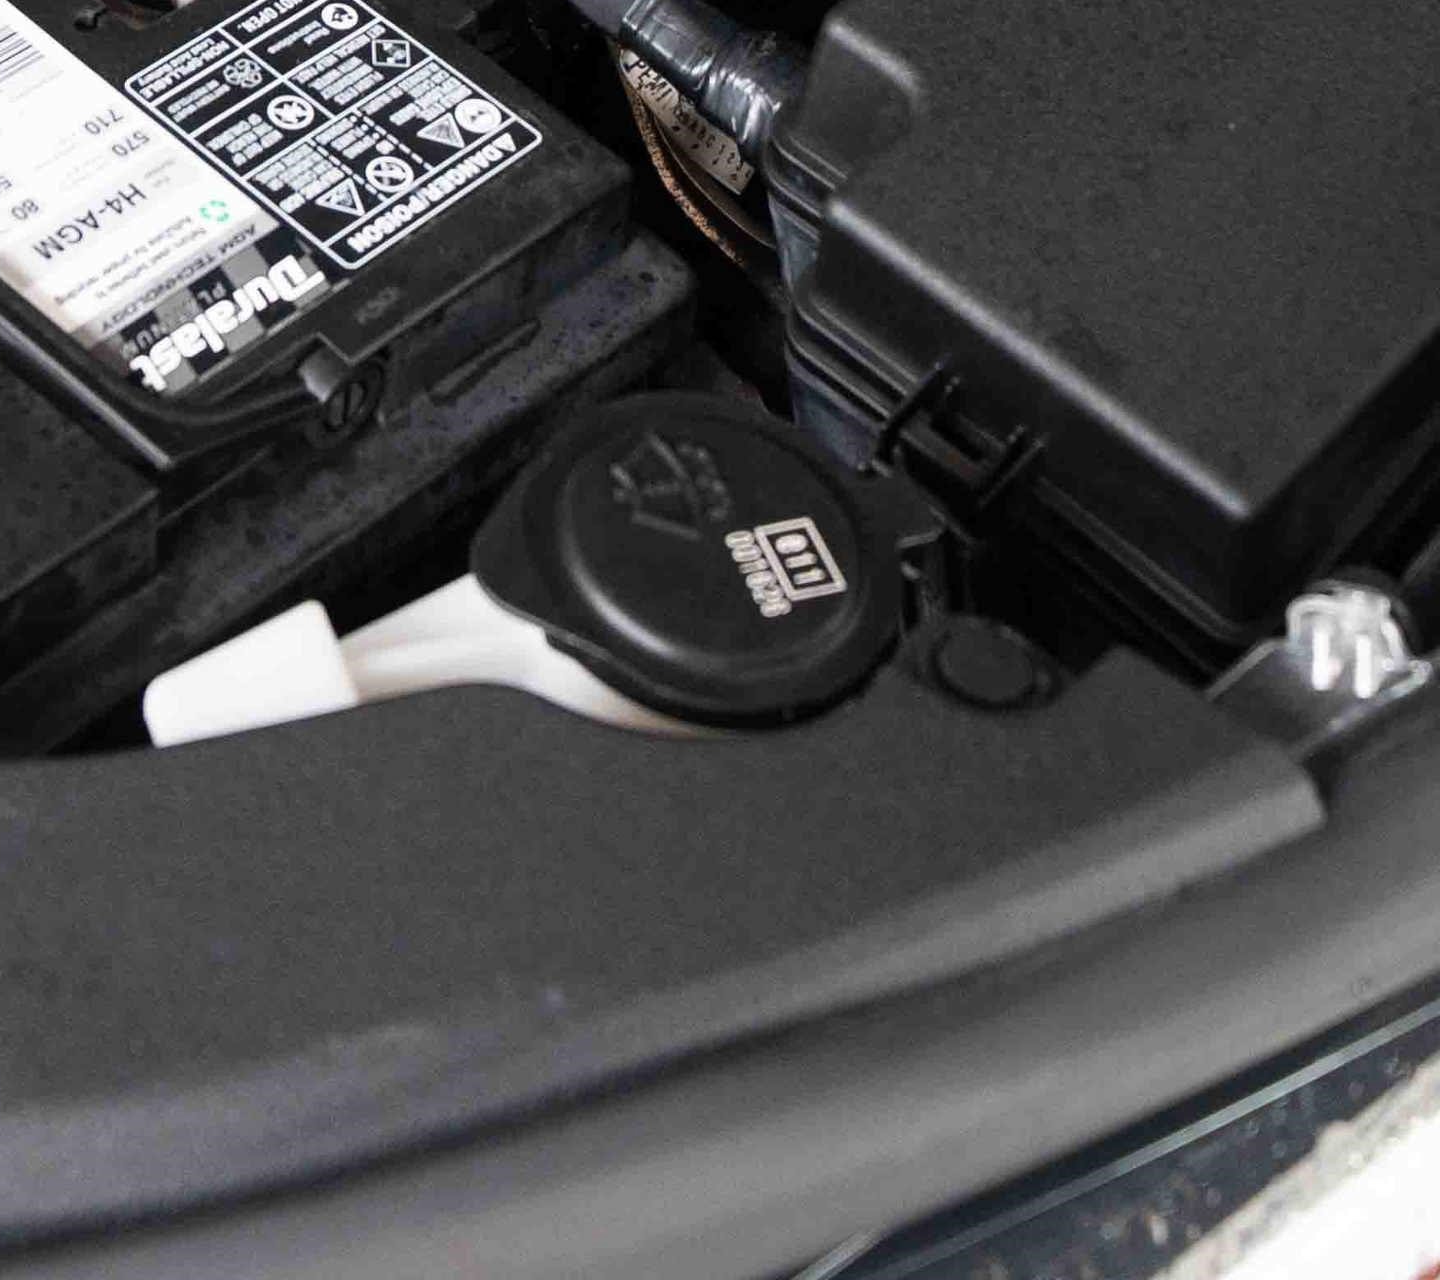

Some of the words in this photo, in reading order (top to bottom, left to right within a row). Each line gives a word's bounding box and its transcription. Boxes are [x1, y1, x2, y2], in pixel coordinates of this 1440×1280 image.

[79, 106, 125, 137] 710
[107, 128, 153, 160] 570
[5, 195, 43, 223] 80
[28, 180, 150, 264] H4-AGM
[344, 141, 505, 254] DANGER/POISON
[212, 221, 261, 256] AGM
[94, 250, 217, 337] TECHNOLOGY
[123, 246, 326, 398] Duralast
